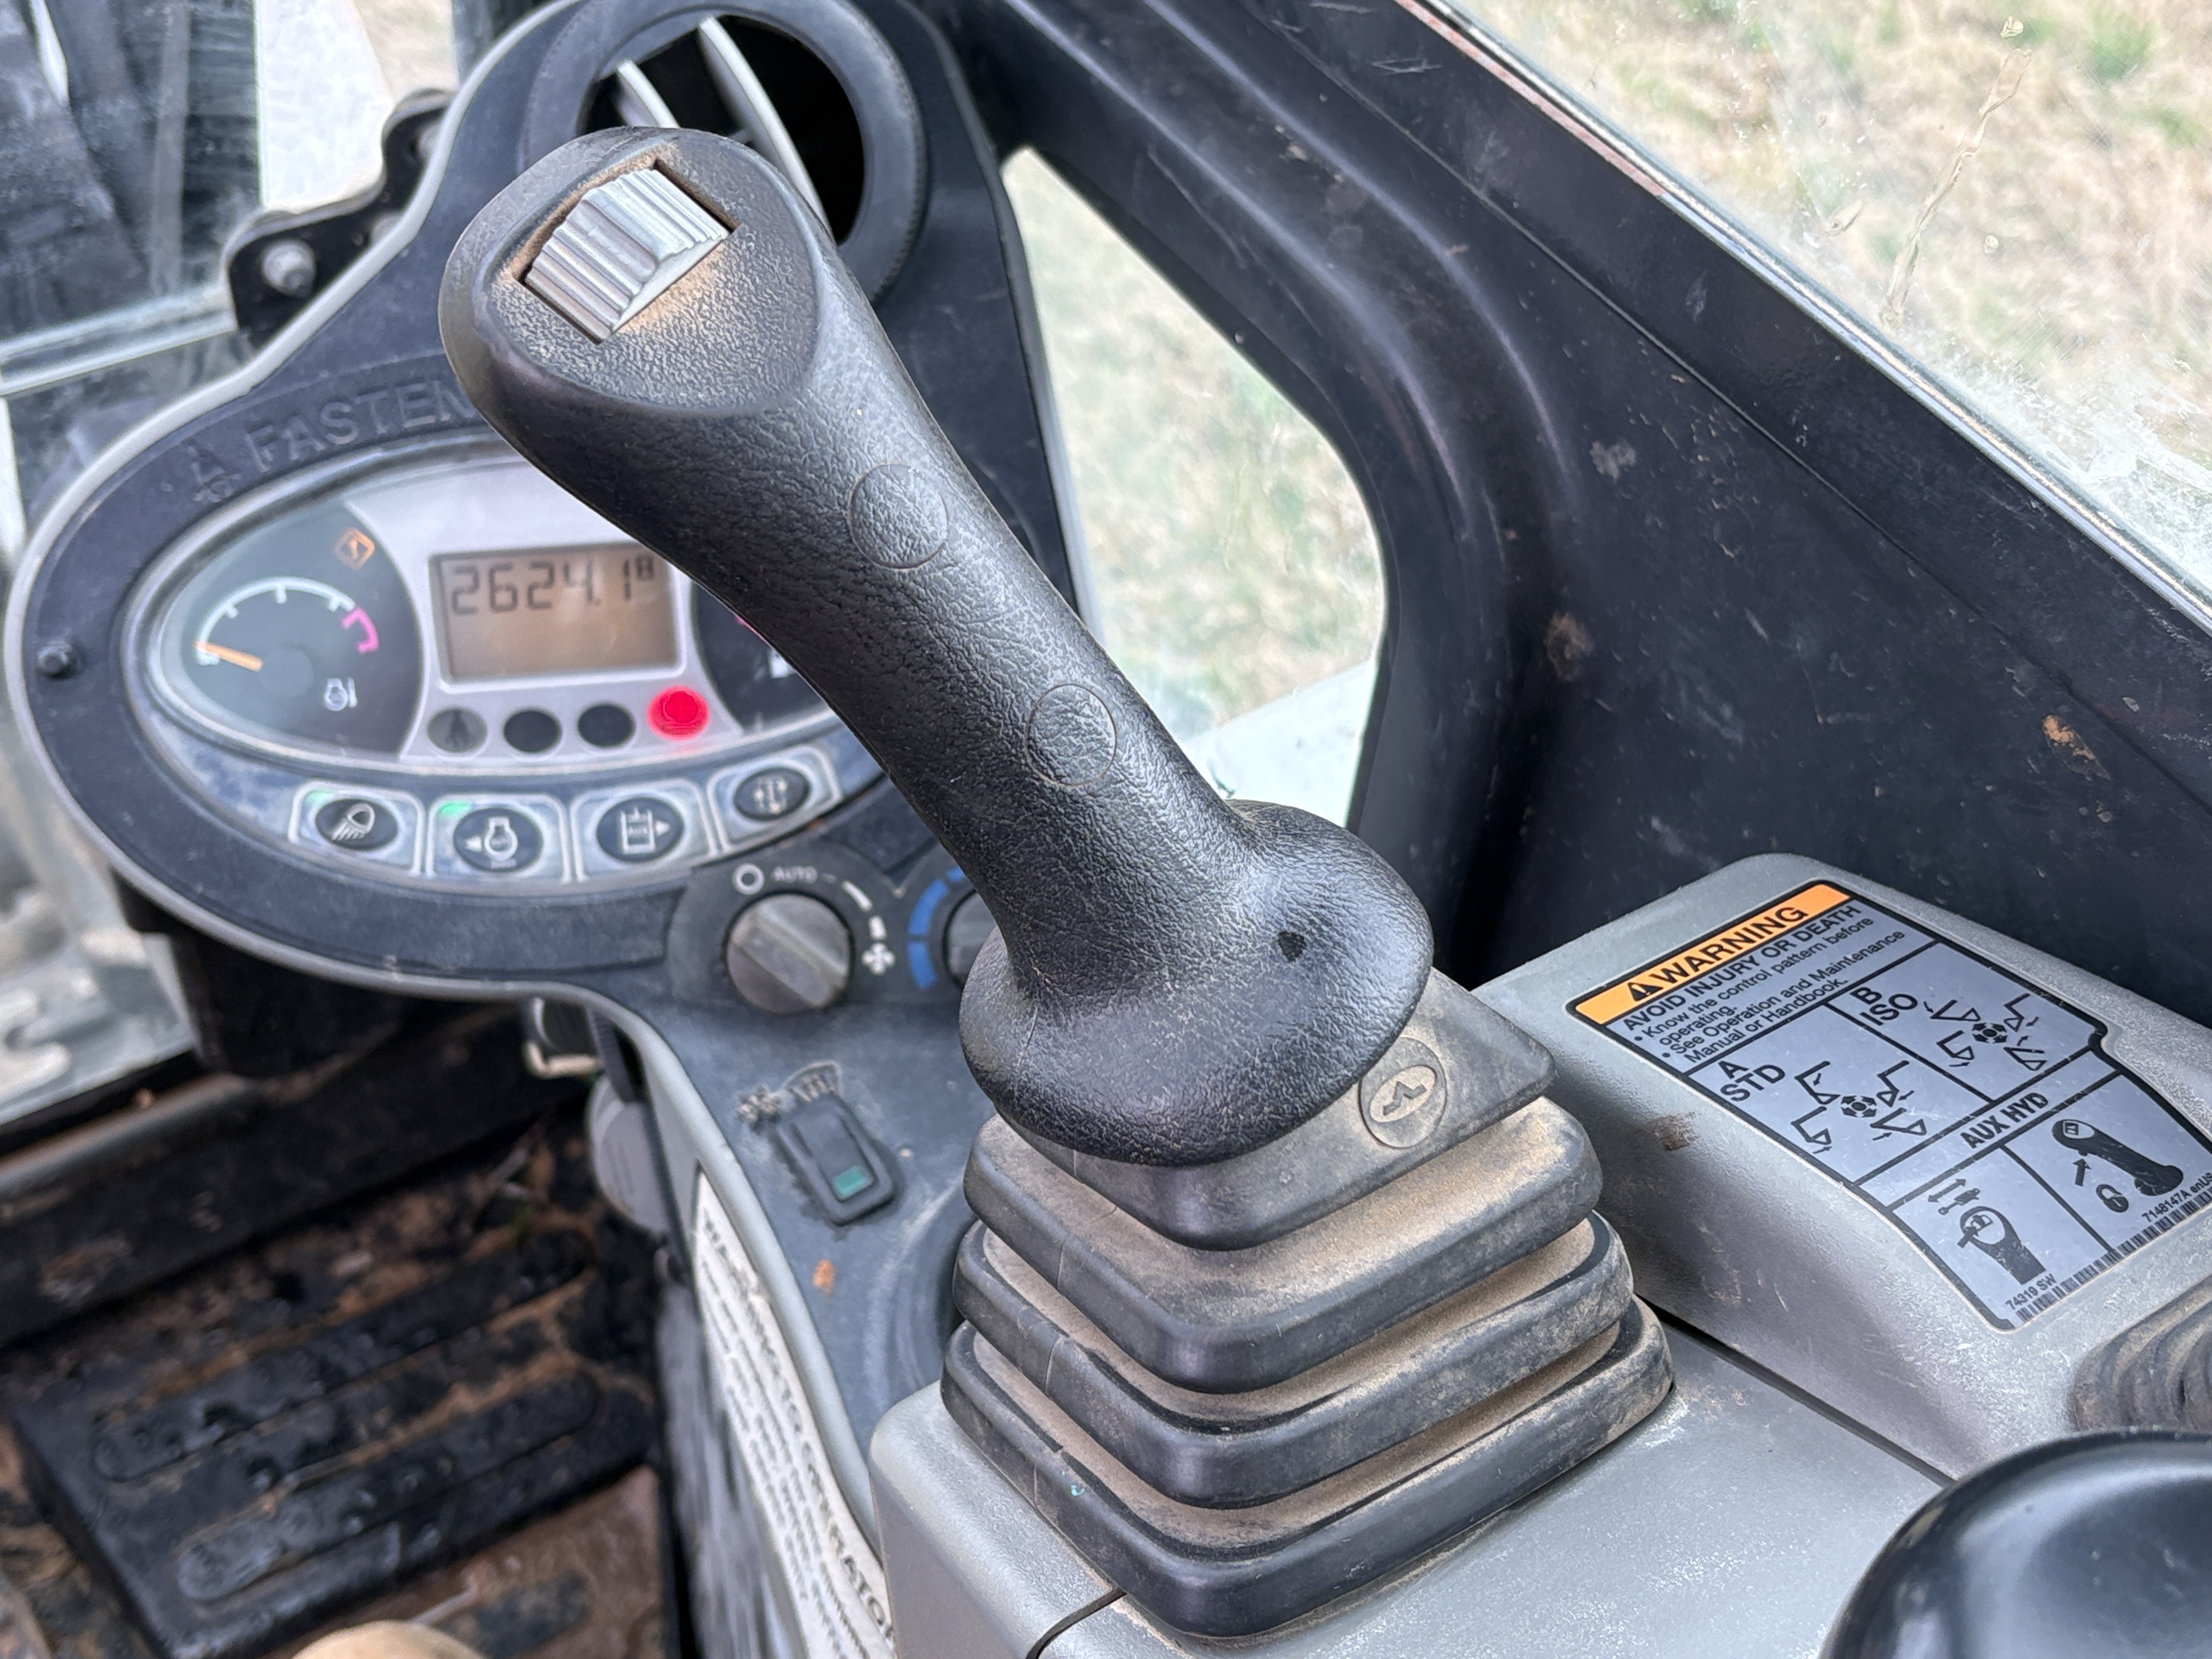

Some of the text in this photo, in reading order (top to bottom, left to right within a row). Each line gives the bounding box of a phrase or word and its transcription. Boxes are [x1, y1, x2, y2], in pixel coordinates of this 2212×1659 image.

[771, 866, 818, 884] AUTO
[1647, 906, 1809, 984] WARNING
[1623, 905, 1862, 1031] AVOID INJURY OR DEATH
[1641, 917, 1874, 1038] Know the control pattern before
[1669, 930, 1905, 1054] See Operation and Maintenance
[1849, 986, 1883, 1005] B
[1859, 993, 1918, 1026] ISO
[1659, 1005, 1738, 1045] operating.
[1683, 977, 1849, 1063] Manual or Handbook.
[1718, 1060, 1750, 1079] A
[1720, 1064, 1786, 1102] STD
[1960, 1092, 2049, 1149] AUX HYD
[2141, 1189, 2192, 1223] 7148147A
[2005, 1273, 2057, 1310] 74319 SW
